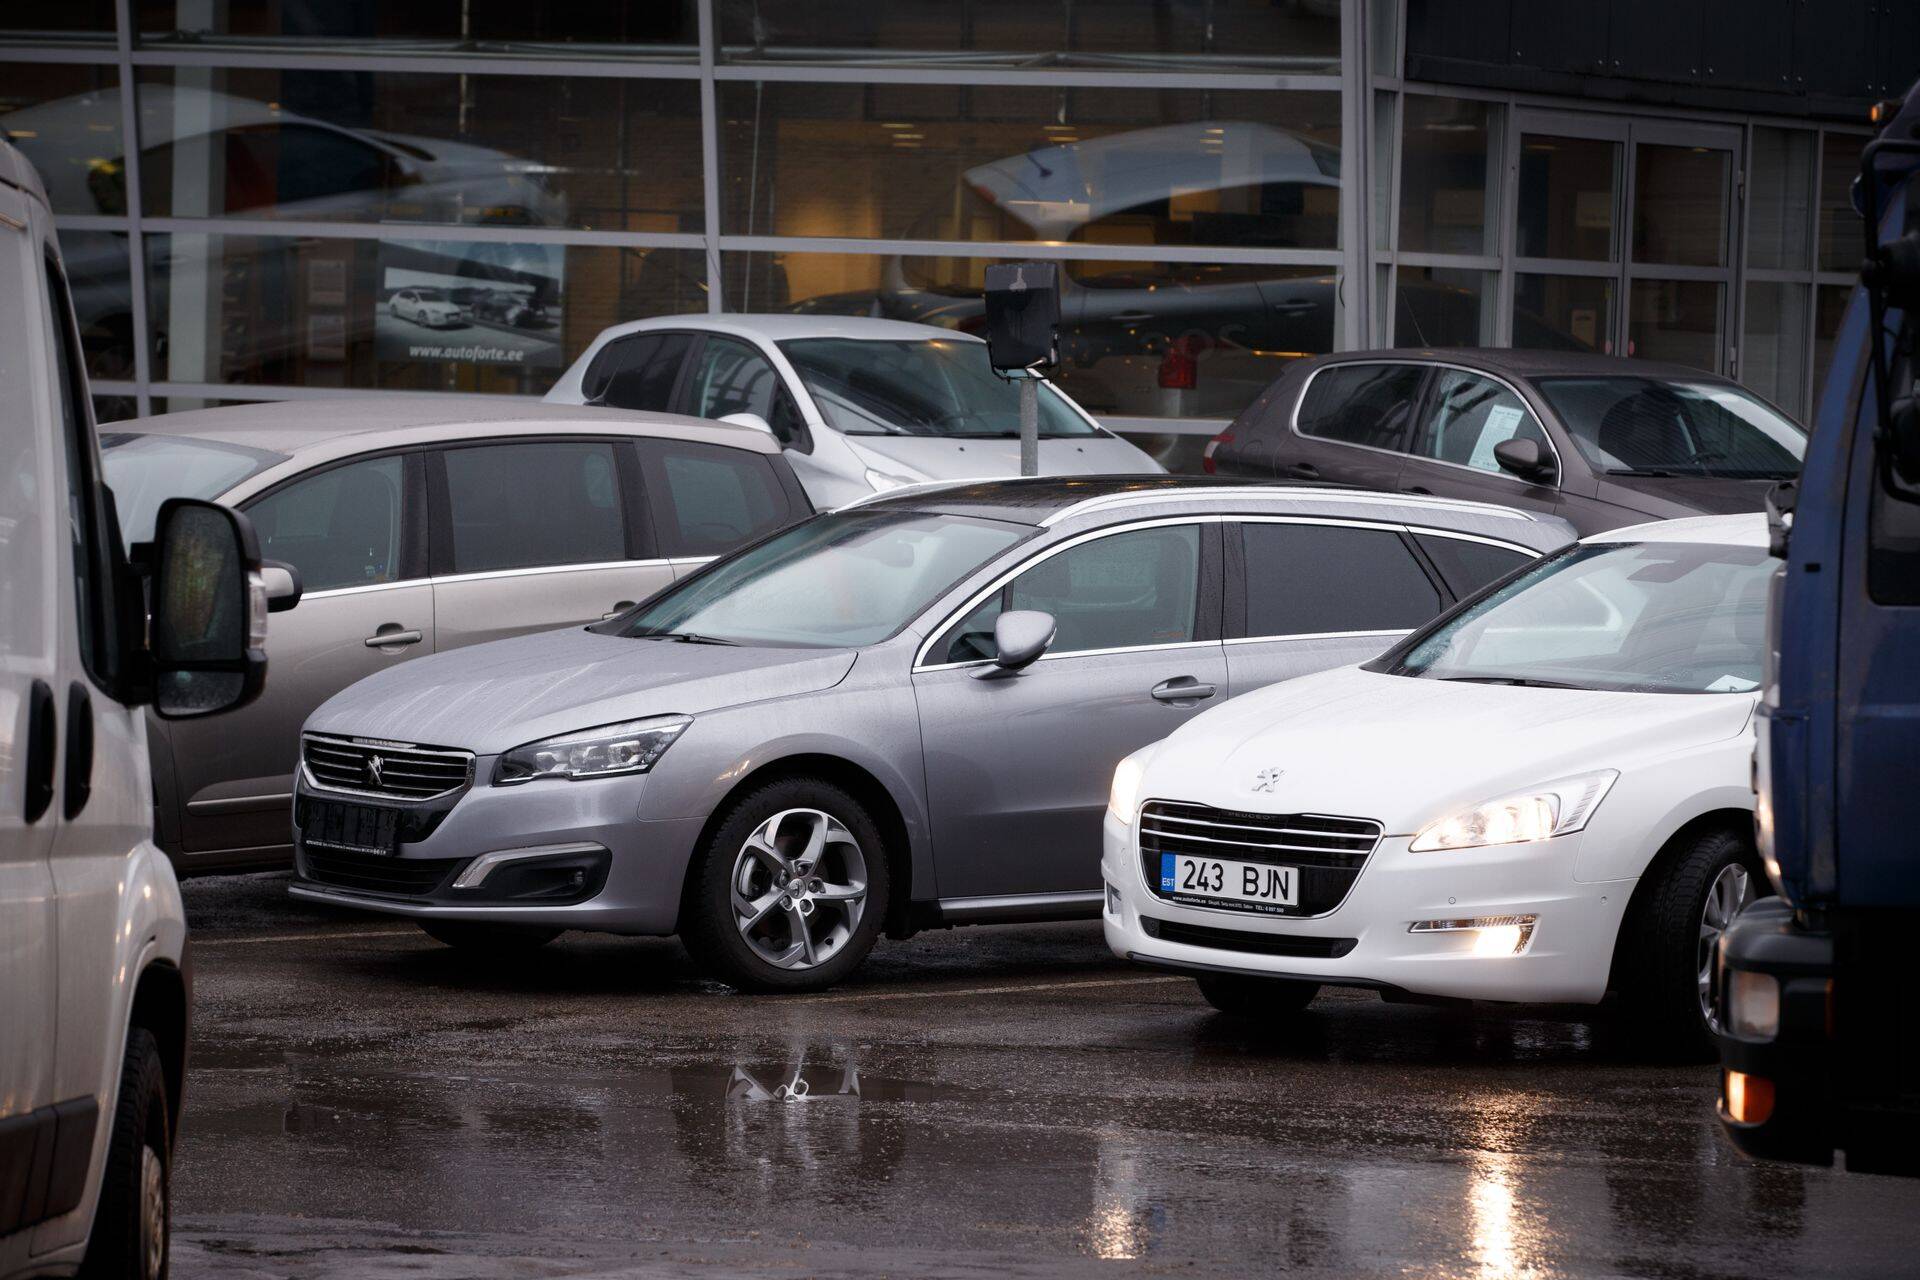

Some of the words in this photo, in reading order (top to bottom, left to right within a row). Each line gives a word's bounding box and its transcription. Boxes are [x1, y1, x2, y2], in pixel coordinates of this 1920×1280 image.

[409, 345, 524, 362] www.autoforte.ee
[1162, 877, 1175, 887] EST
[1183, 860, 1224, 892] 243
[1242, 866, 1289, 900] BJN
